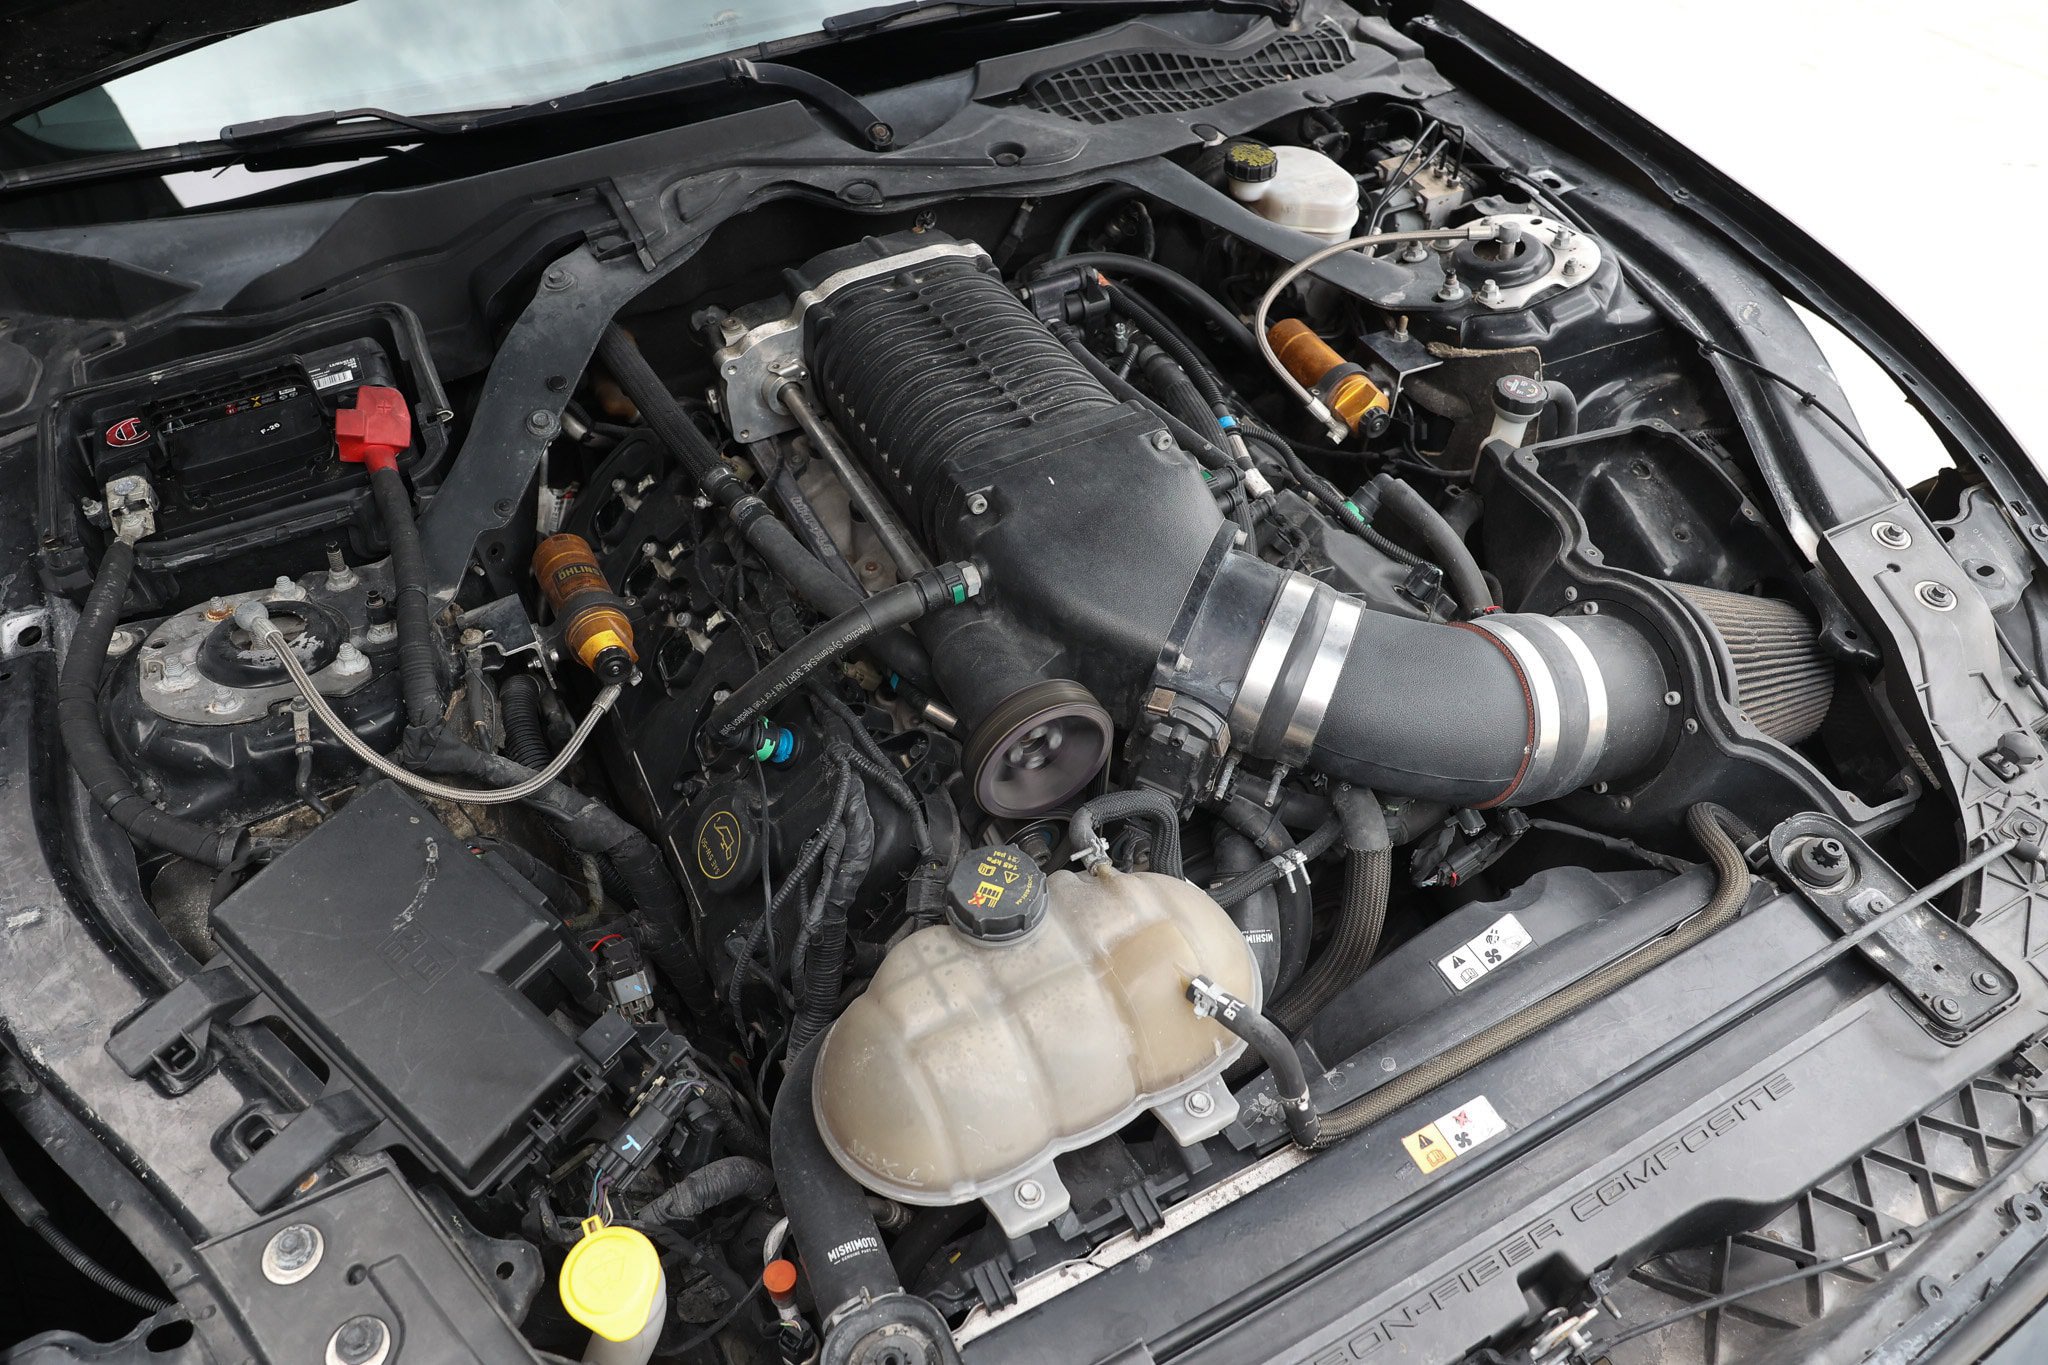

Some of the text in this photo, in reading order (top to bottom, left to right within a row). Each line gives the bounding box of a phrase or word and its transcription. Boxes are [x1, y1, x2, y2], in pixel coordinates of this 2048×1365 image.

[842, 623, 873, 643] Injection
[786, 668, 804, 685] 30R7
[773, 680, 788, 691] Not
[764, 689, 778, 700] For
[752, 697, 768, 710] Fuel
[731, 706, 756, 726] Injection
[986, 856, 1018, 871] 145 kPa
[1570, 1072, 1796, 1223] COMPOSITE
[827, 1236, 878, 1263] MISHIMOTO
